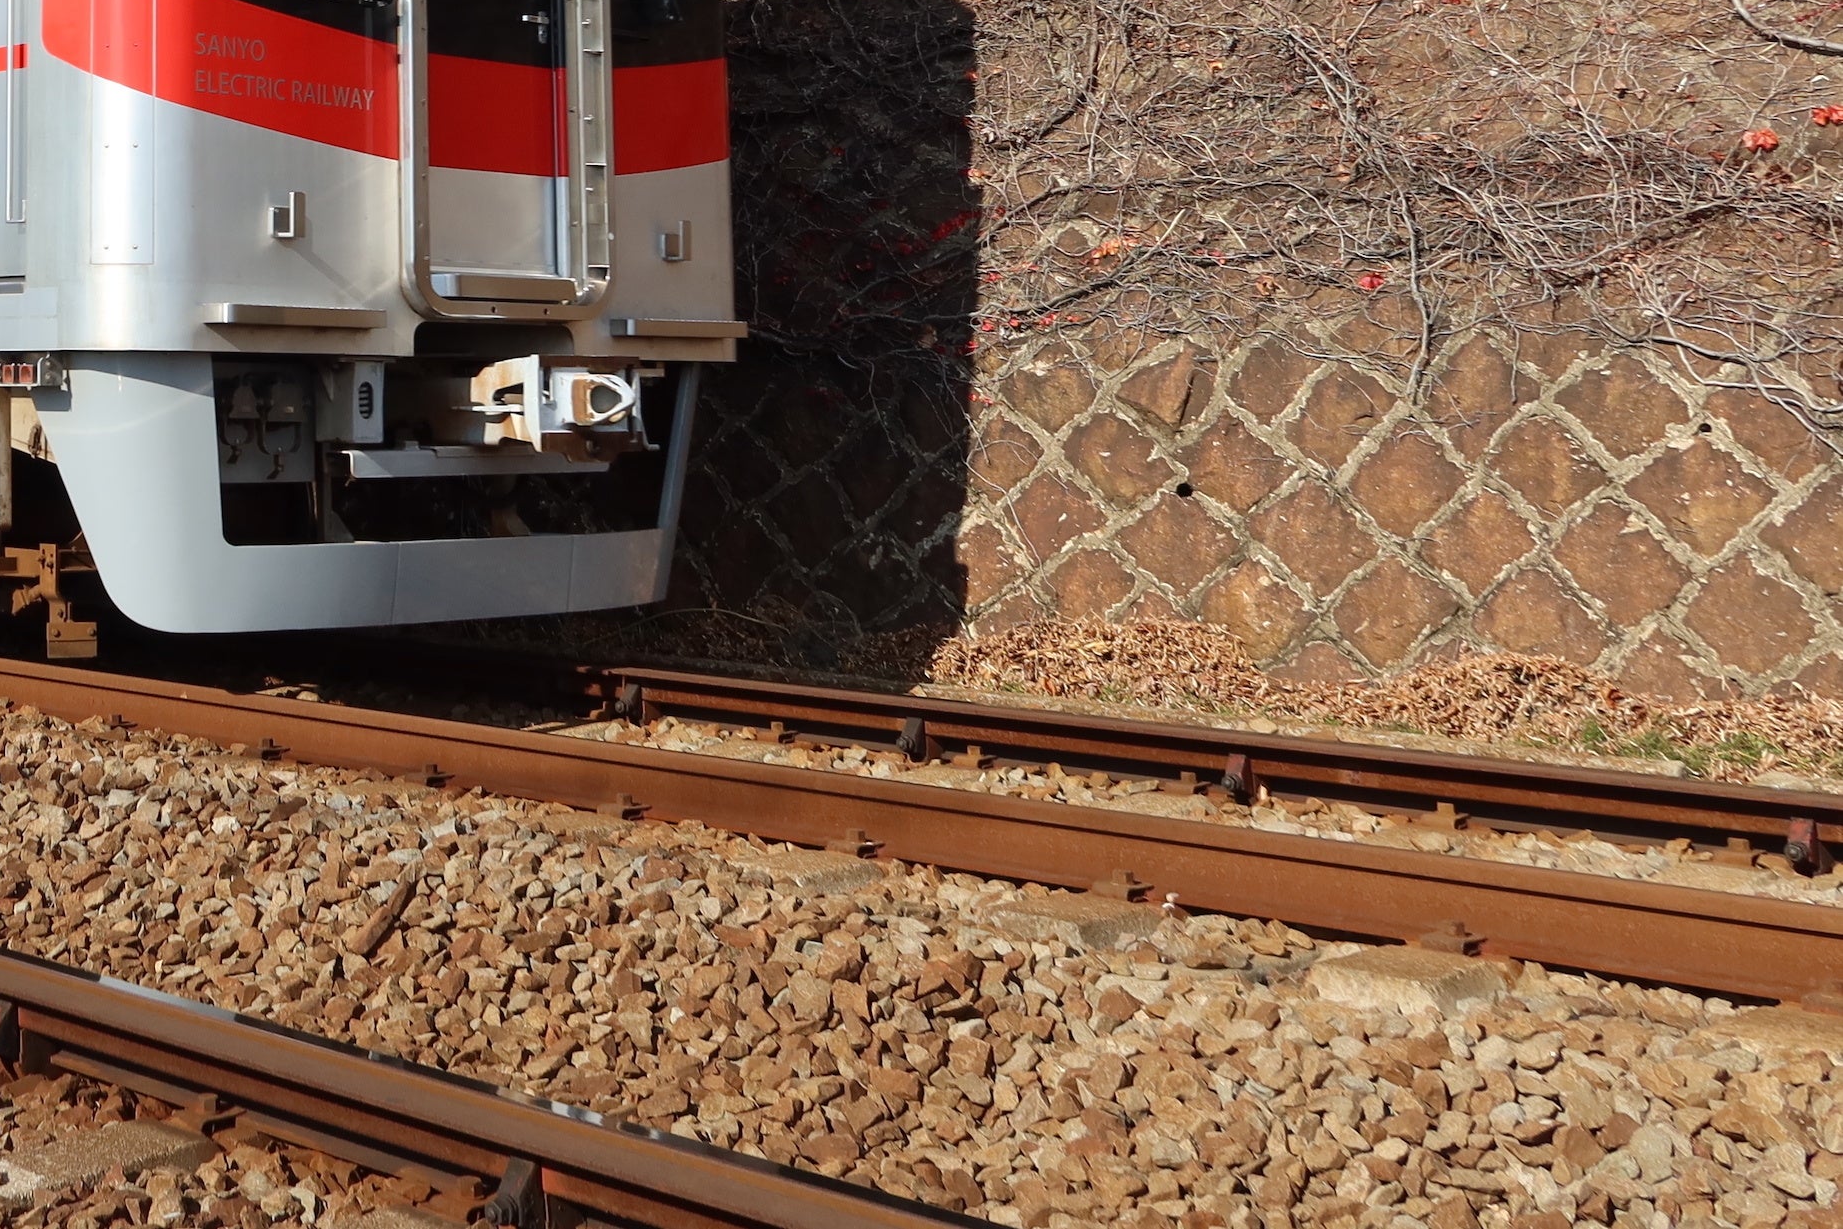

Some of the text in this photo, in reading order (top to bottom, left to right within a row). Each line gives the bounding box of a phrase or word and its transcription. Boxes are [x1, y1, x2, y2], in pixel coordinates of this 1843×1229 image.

[195, 32, 266, 62] SANYO
[195, 69, 374, 112] ELECTRIC RAILWAY
